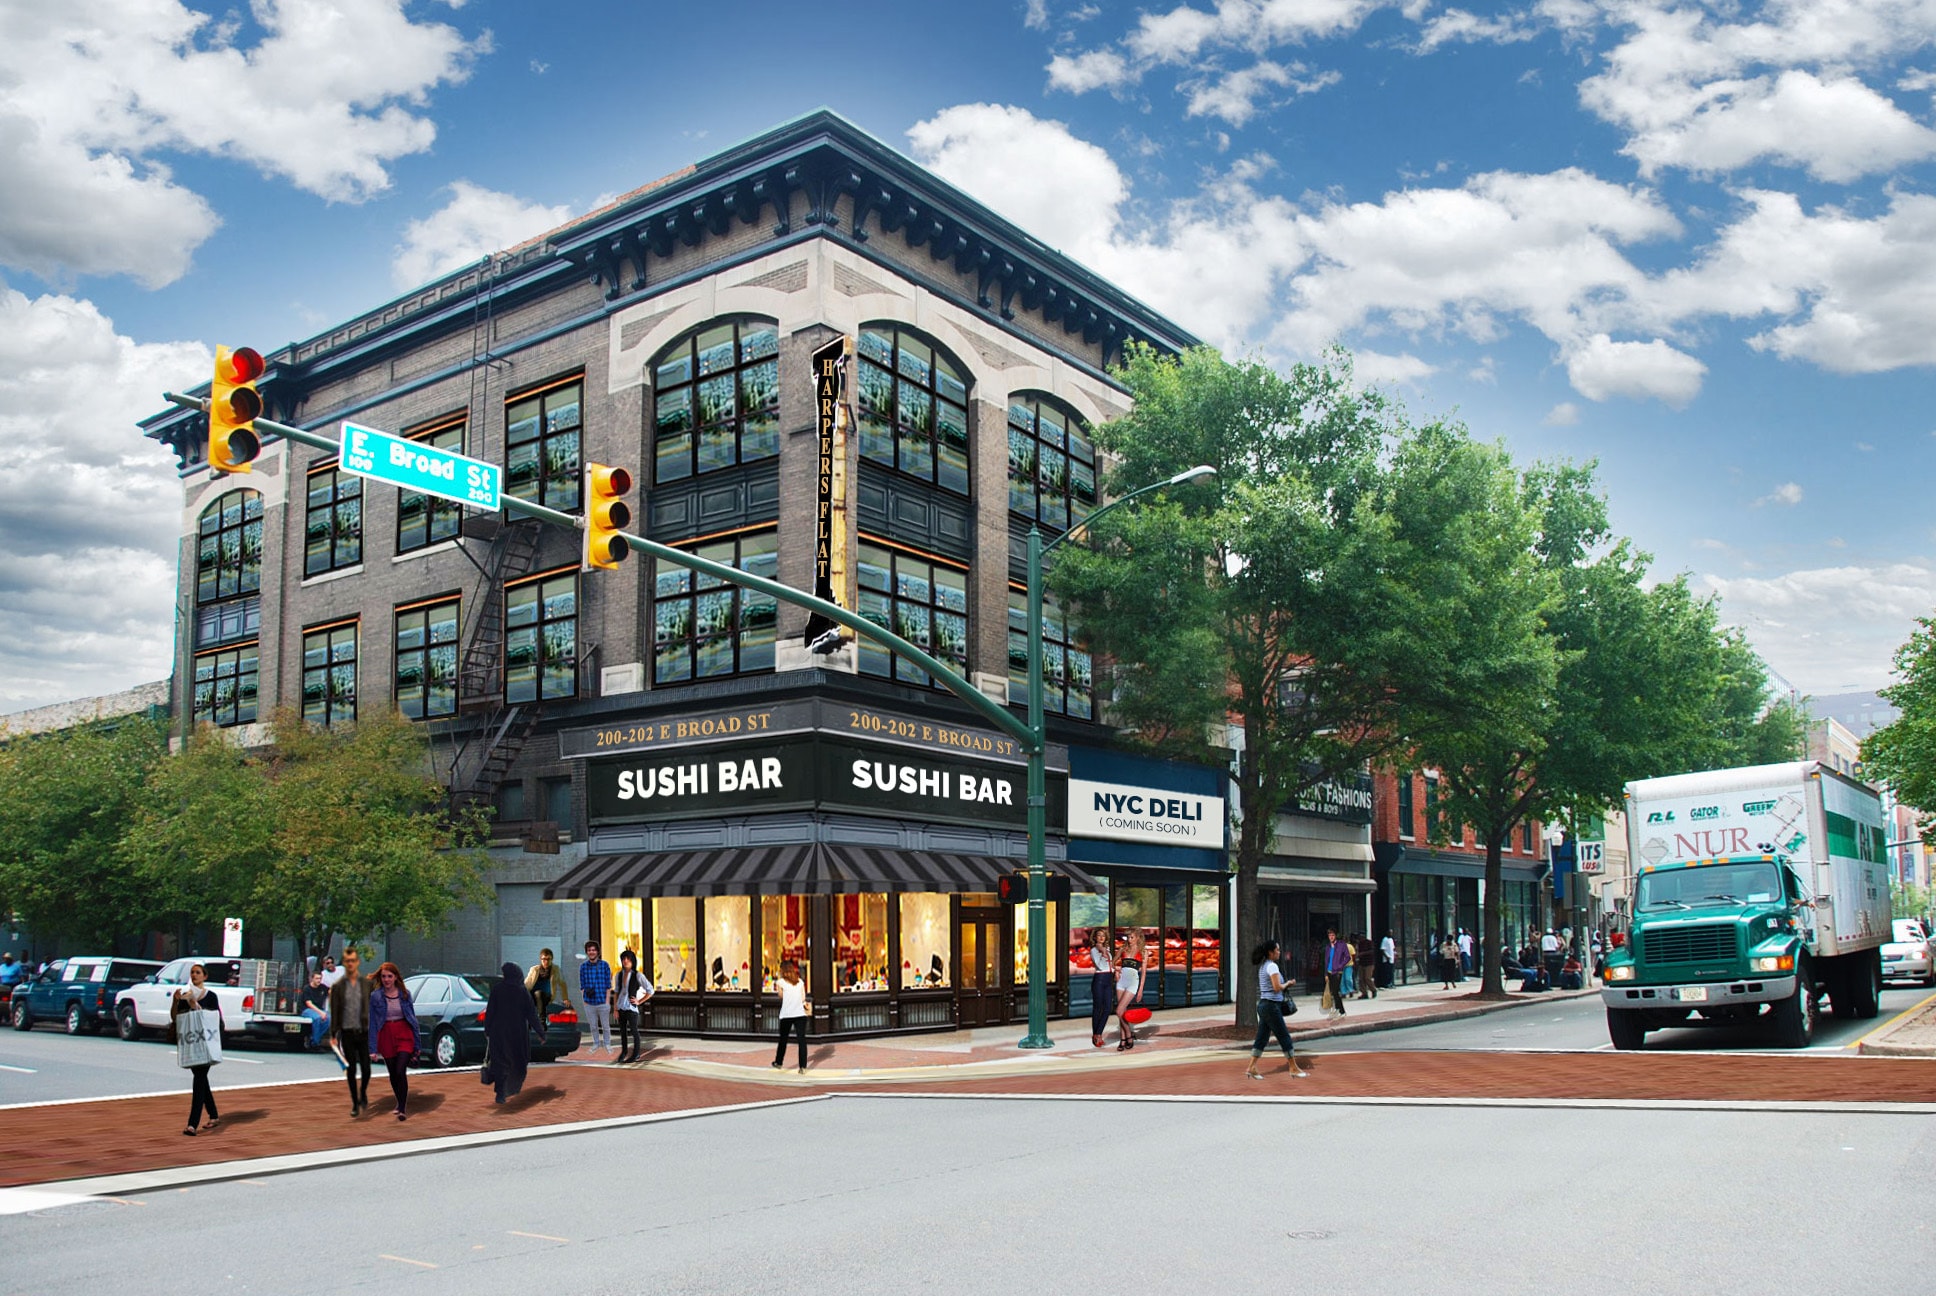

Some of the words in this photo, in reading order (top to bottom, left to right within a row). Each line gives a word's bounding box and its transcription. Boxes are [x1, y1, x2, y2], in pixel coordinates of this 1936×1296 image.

[820, 359, 833, 494] HARPERS
[348, 454, 373, 471] 100
[351, 431, 375, 458] E.
[389, 442, 455, 480] Broad
[467, 465, 491, 491] St
[467, 486, 492, 503] 200
[818, 501, 829, 577] FLAT
[596, 726, 654, 746] 200-202
[660, 723, 671, 740] E
[677, 717, 741, 739] BROAD
[747, 713, 771, 731] ST
[850, 712, 916, 738] 200-202
[922, 725, 933, 741] E
[938, 728, 993, 752] BROAD
[996, 741, 1013, 756] ST
[617, 763, 709, 800] SUSHI
[718, 757, 784, 793] BAR
[852, 760, 950, 799] SUSHI
[959, 774, 1013, 806] BAR
[1093, 792, 1144, 815] NYC
[1149, 798, 1202, 821] DELI
[1323, 803, 1339, 815] BOYS
[1326, 784, 1372, 809] FASHIONS
[1690, 805, 1719, 818] GATOR
[1673, 827, 1753, 859] NUR
